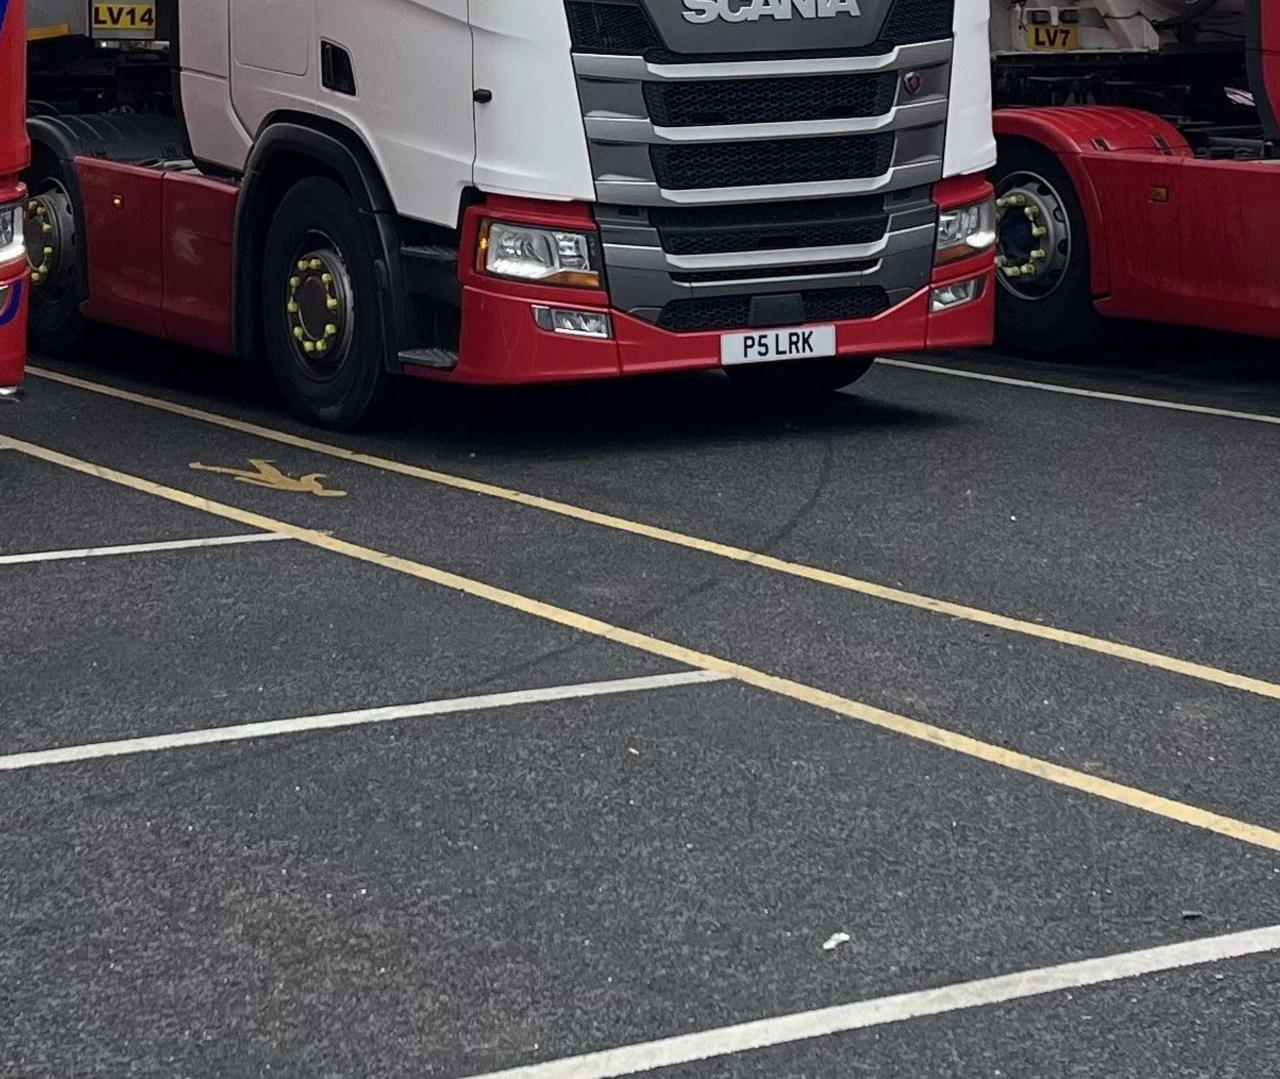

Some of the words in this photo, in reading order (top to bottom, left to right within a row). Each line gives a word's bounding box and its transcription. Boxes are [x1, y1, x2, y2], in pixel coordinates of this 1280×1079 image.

[93, 6, 154, 26] LV14
[1034, 27, 1071, 47] LV7
[743, 334, 770, 358] P5
[775, 331, 814, 355] LRK
